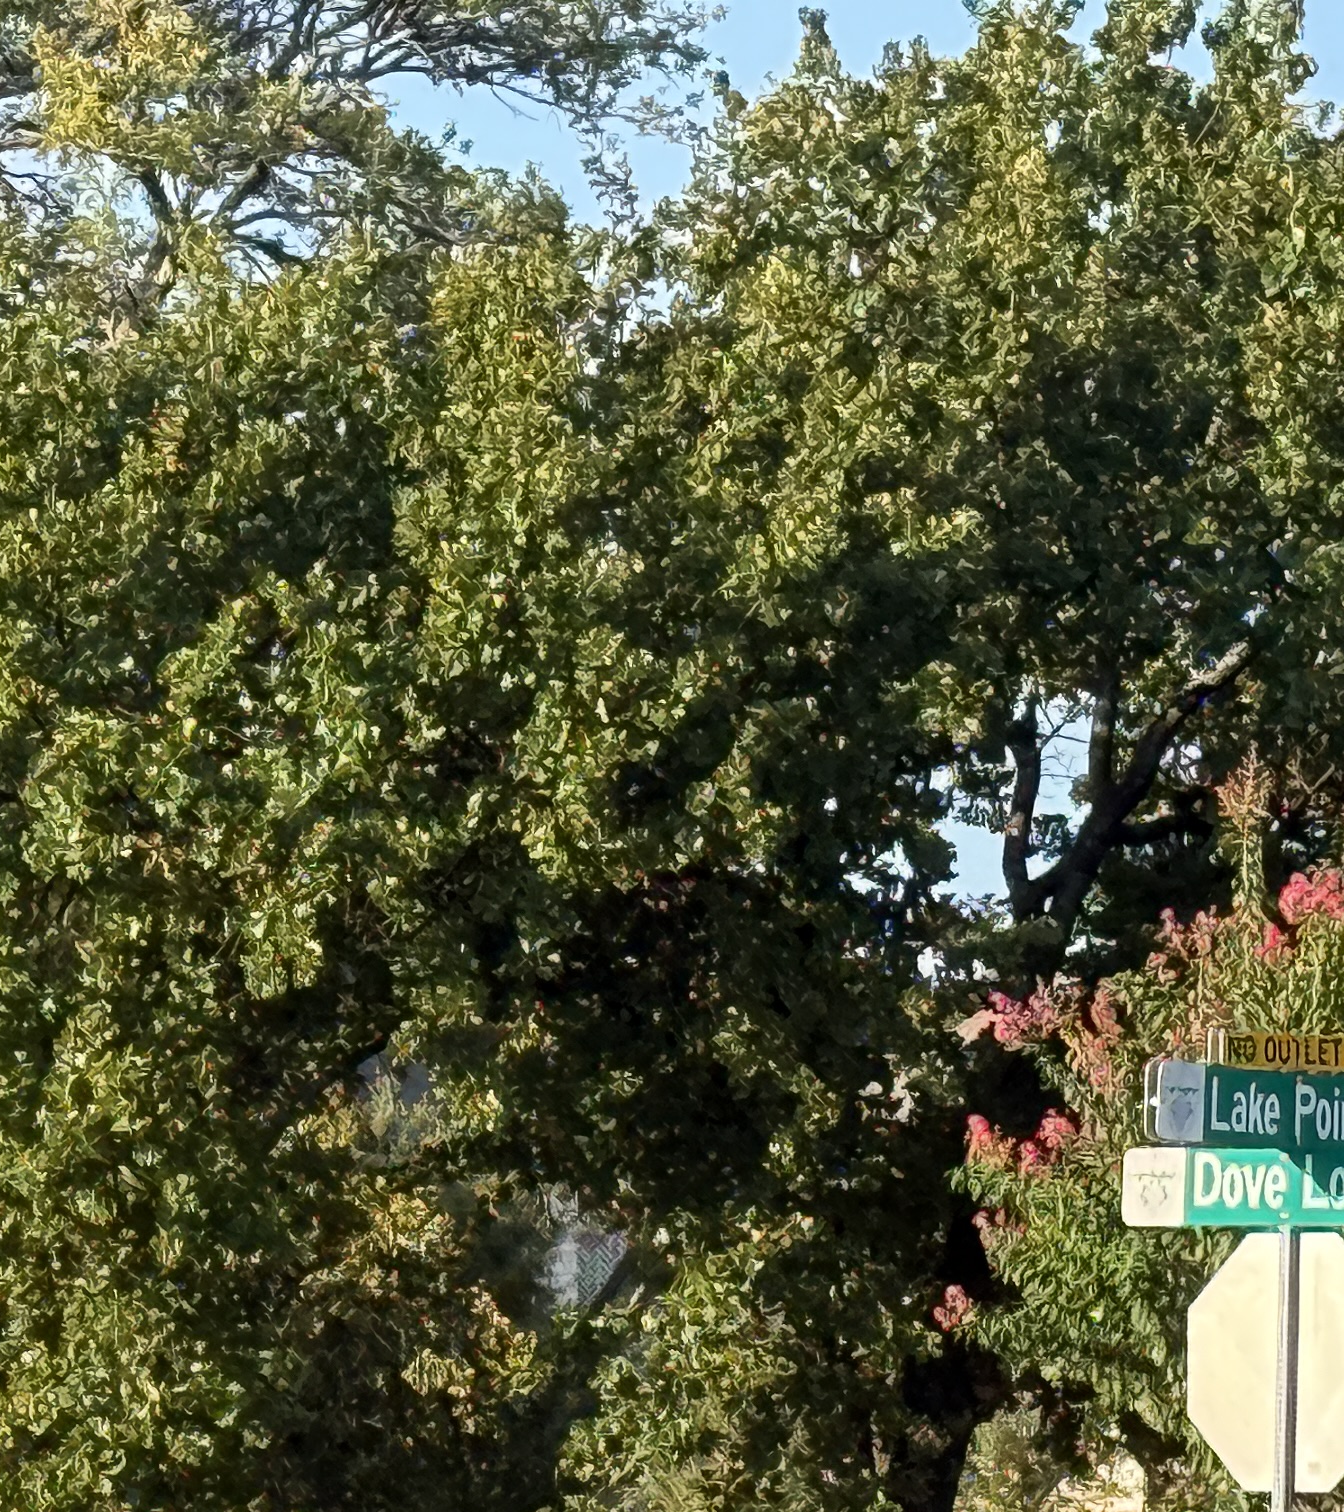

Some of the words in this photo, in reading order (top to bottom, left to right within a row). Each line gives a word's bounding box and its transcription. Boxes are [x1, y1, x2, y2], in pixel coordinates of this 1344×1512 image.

[1264, 1035, 1343, 1068] OUTLET
[1210, 1075, 1281, 1136] Lake
[1193, 1151, 1288, 1210] Dove
